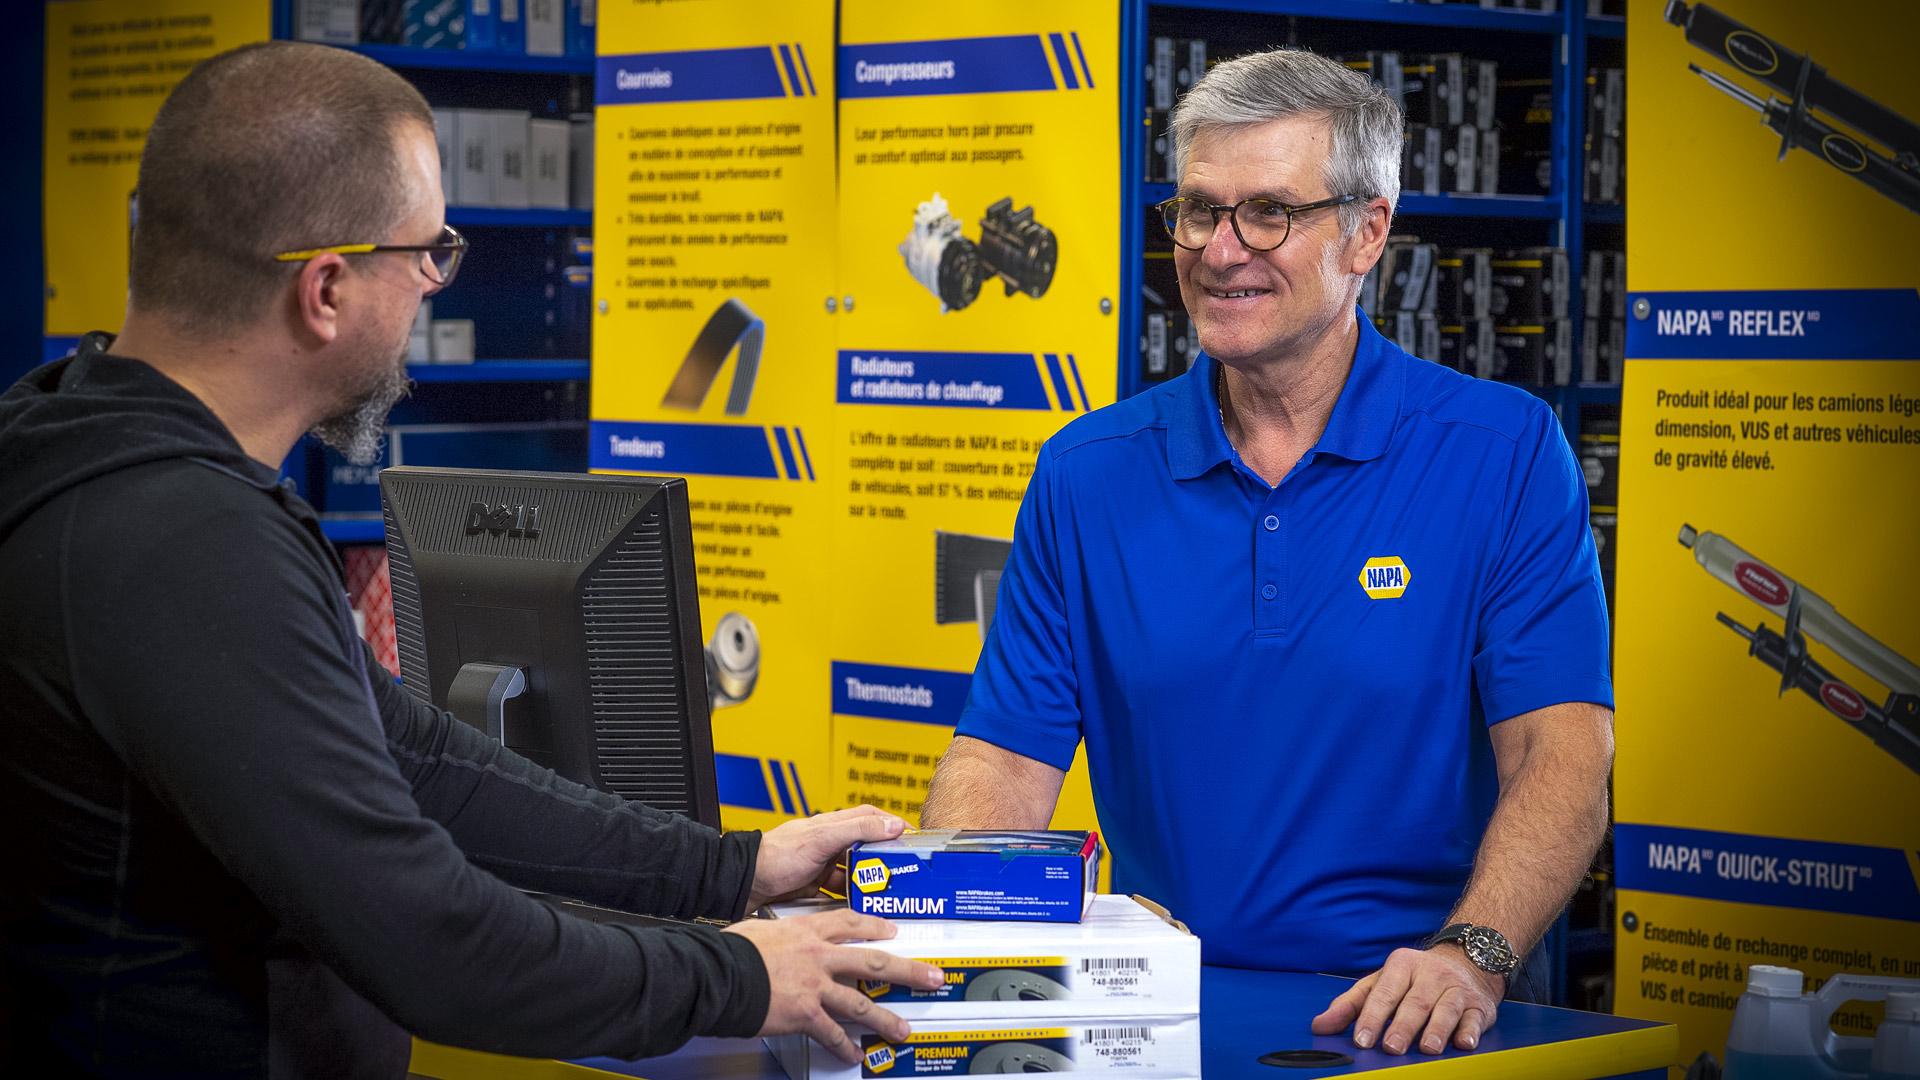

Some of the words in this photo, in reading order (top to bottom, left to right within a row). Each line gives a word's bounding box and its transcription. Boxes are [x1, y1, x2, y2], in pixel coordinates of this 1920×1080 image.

[616, 68, 673, 90] Courroies
[855, 60, 955, 85] Compresseurs
[1657, 310, 1711, 336] NAPA
[1729, 310, 1805, 336] REFLEX
[851, 356, 914, 377] Radiateurs
[850, 378, 864, 398] et
[866, 378, 924, 399] radiateurs
[926, 379, 941, 400] de
[943, 380, 1003, 405] chauffage
[1657, 390, 1709, 408] Produit
[1714, 390, 1749, 410] idéal
[1754, 395, 1787, 413] pour
[1792, 393, 1813, 411] les
[1819, 394, 1884, 413] camions
[1655, 419, 1735, 442] dimension,
[1740, 422, 1770, 440] VUS
[1774, 425, 1788, 441] et
[1793, 425, 1841, 442] autres
[1846, 424, 1920, 444] véhicules
[609, 435, 665, 458] Tendeurs
[1654, 450, 1672, 466] de
[1676, 450, 1727, 471] gravité
[1732, 451, 1774, 470] élevé.
[465, 502, 542, 539] DELL
[1367, 567, 1404, 588] NAPA
[845, 677, 933, 708] Thermostats
[858, 867, 885, 885] NAPA
[1649, 843, 1701, 874] NAPA
[1717, 852, 1857, 892] QUICK-STRUT
[1644, 922, 1709, 948] Ensemble
[1713, 932, 1731, 951] de
[1736, 936, 1808, 961] rechange
[1812, 946, 1876, 973] complet,
[1881, 955, 1898, 972] en
[1642, 953, 1677, 973] pièce
[1682, 958, 1695, 976] et
[1700, 961, 1729, 981] prêt
[1734, 963, 1743, 982] à
[1092, 977, 1138, 986] 748-880561
[1641, 981, 1666, 1000] VUS
[1671, 985, 1685, 1003] et
[1688, 989, 1740, 1010] camio
[868, 1047, 893, 1067] NAPA
[1095, 1047, 1142, 1056] 748-880561
